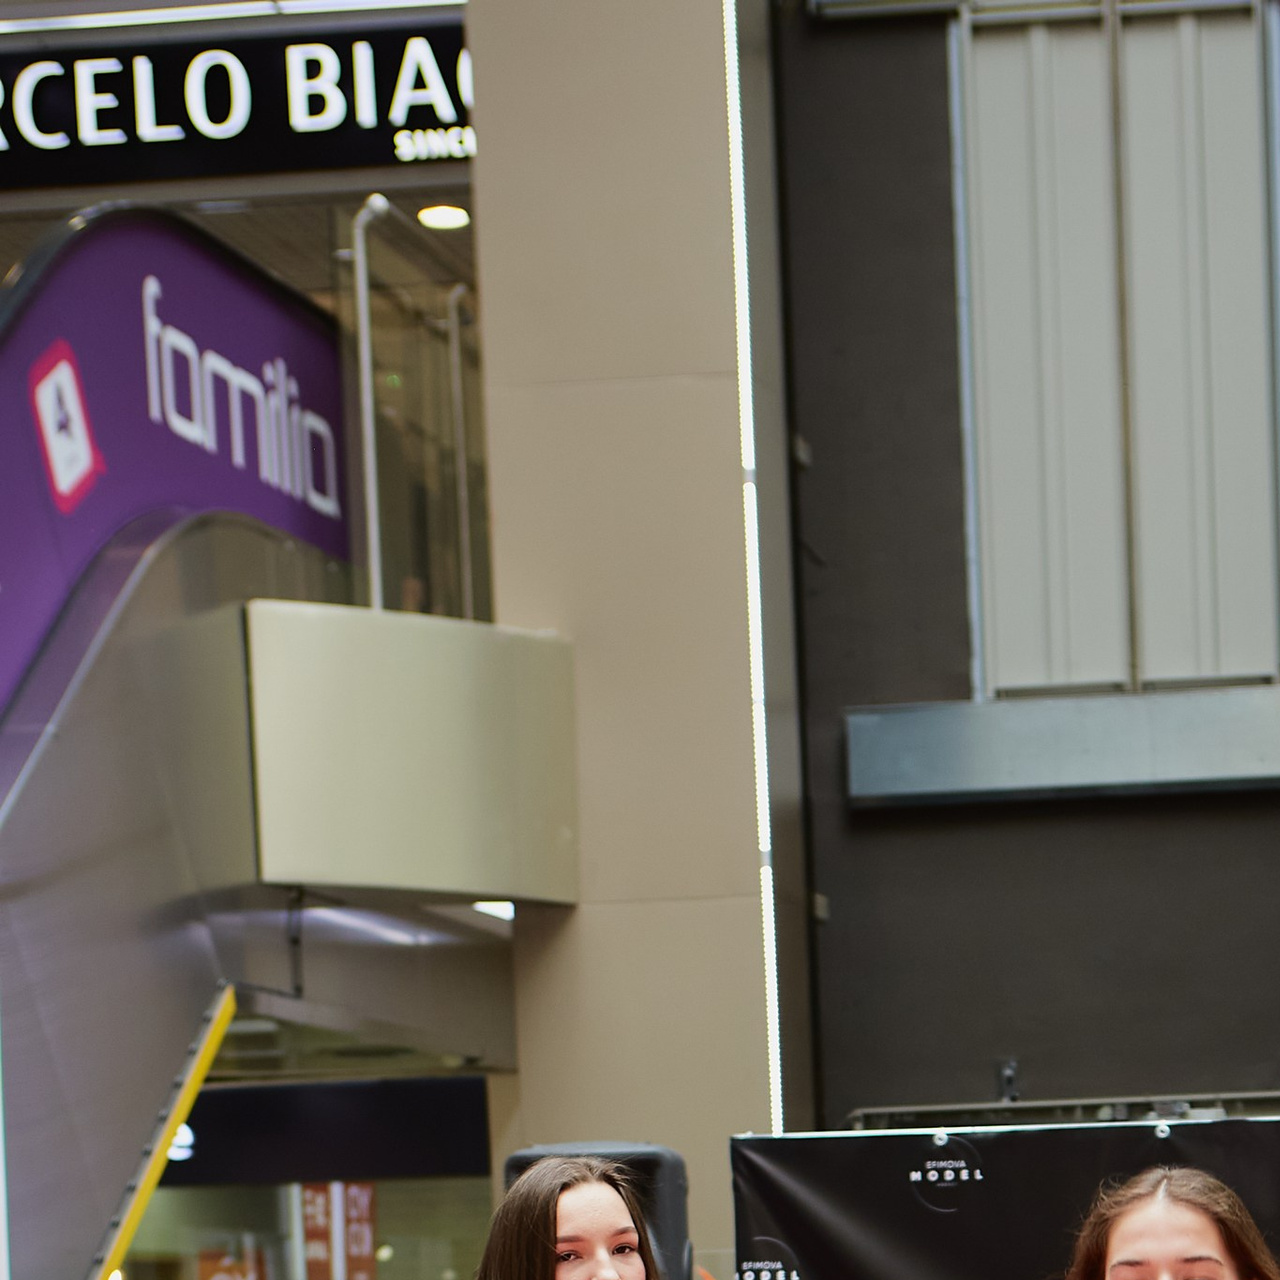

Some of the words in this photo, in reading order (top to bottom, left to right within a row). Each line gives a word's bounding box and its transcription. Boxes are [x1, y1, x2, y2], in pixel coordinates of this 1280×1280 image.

[925, 1160, 967, 1169] EFIMOVA
[909, 1168, 984, 1182] MODEL
[742, 1261, 783, 1271] EFIMOVA
